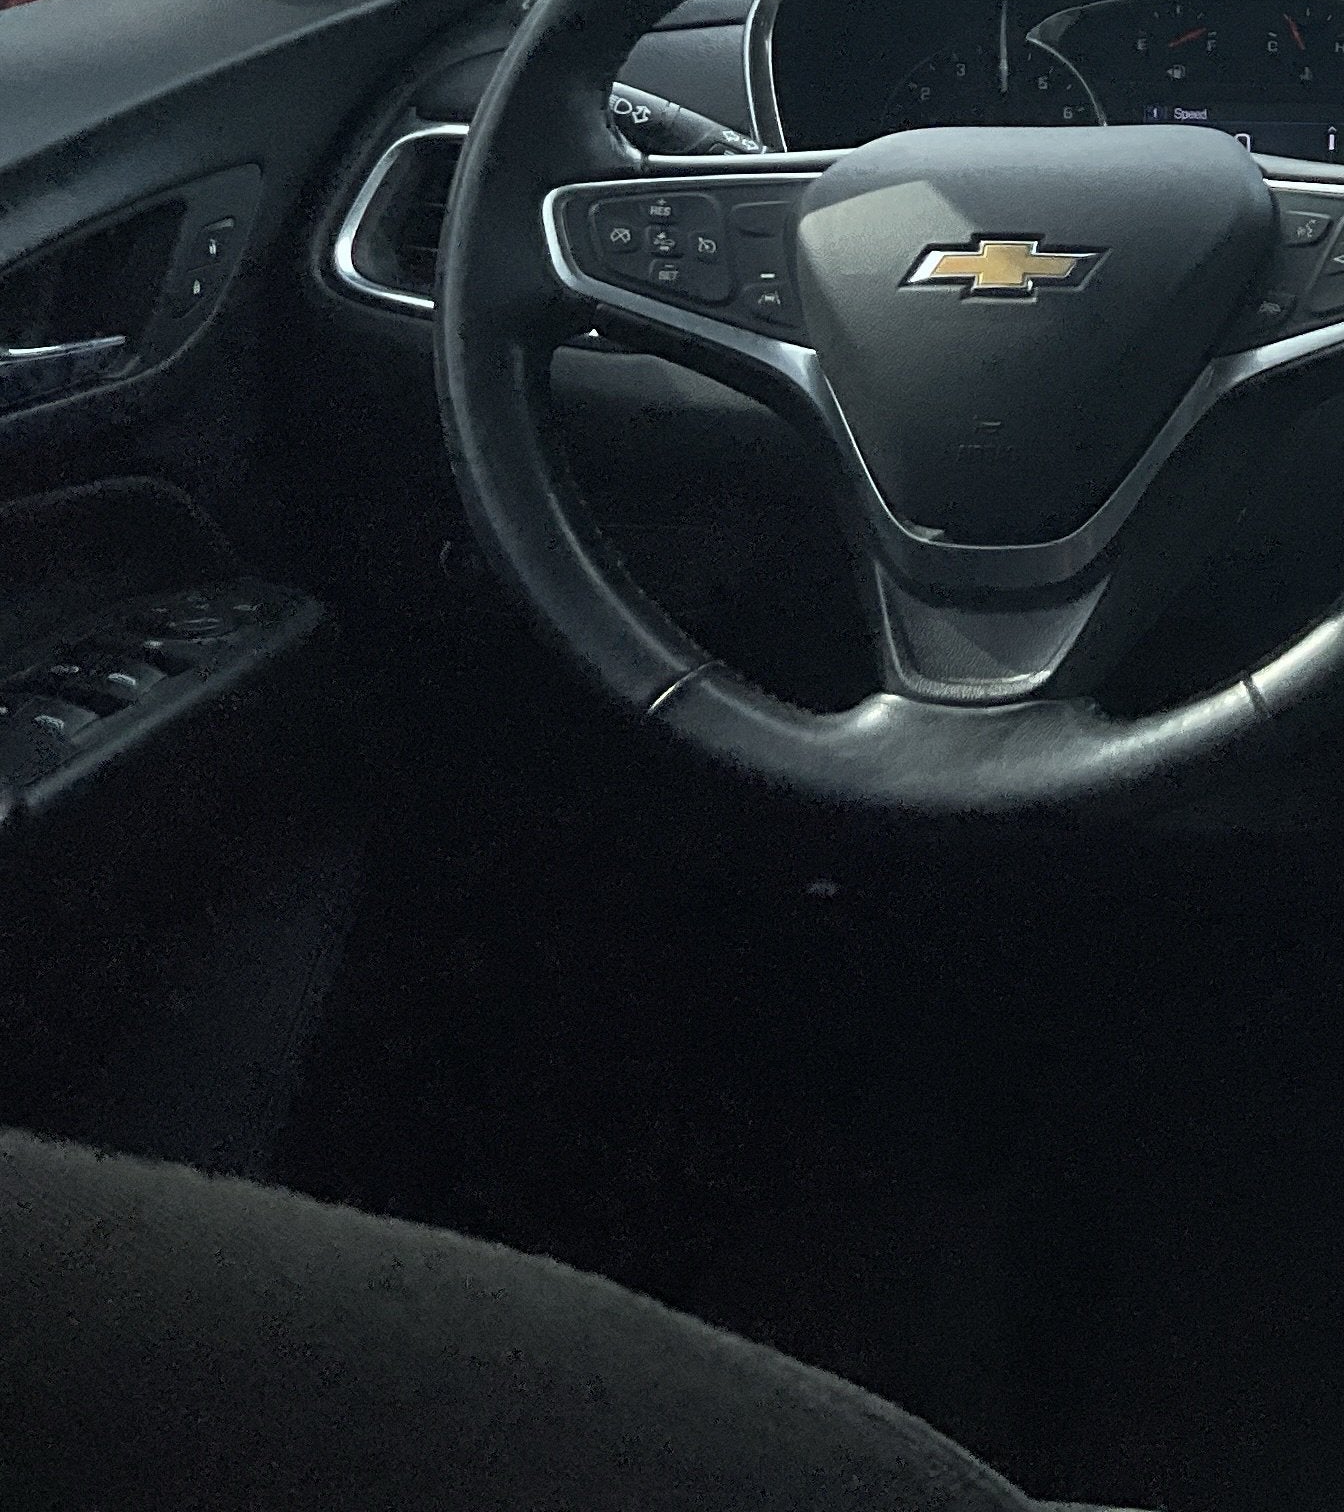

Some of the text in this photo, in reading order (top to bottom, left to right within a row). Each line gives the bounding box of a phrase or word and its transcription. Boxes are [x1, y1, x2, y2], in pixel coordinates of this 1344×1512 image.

[956, 63, 966, 77] 3
[1062, 105, 1074, 119] 6
[1173, 107, 1208, 120] Speed
